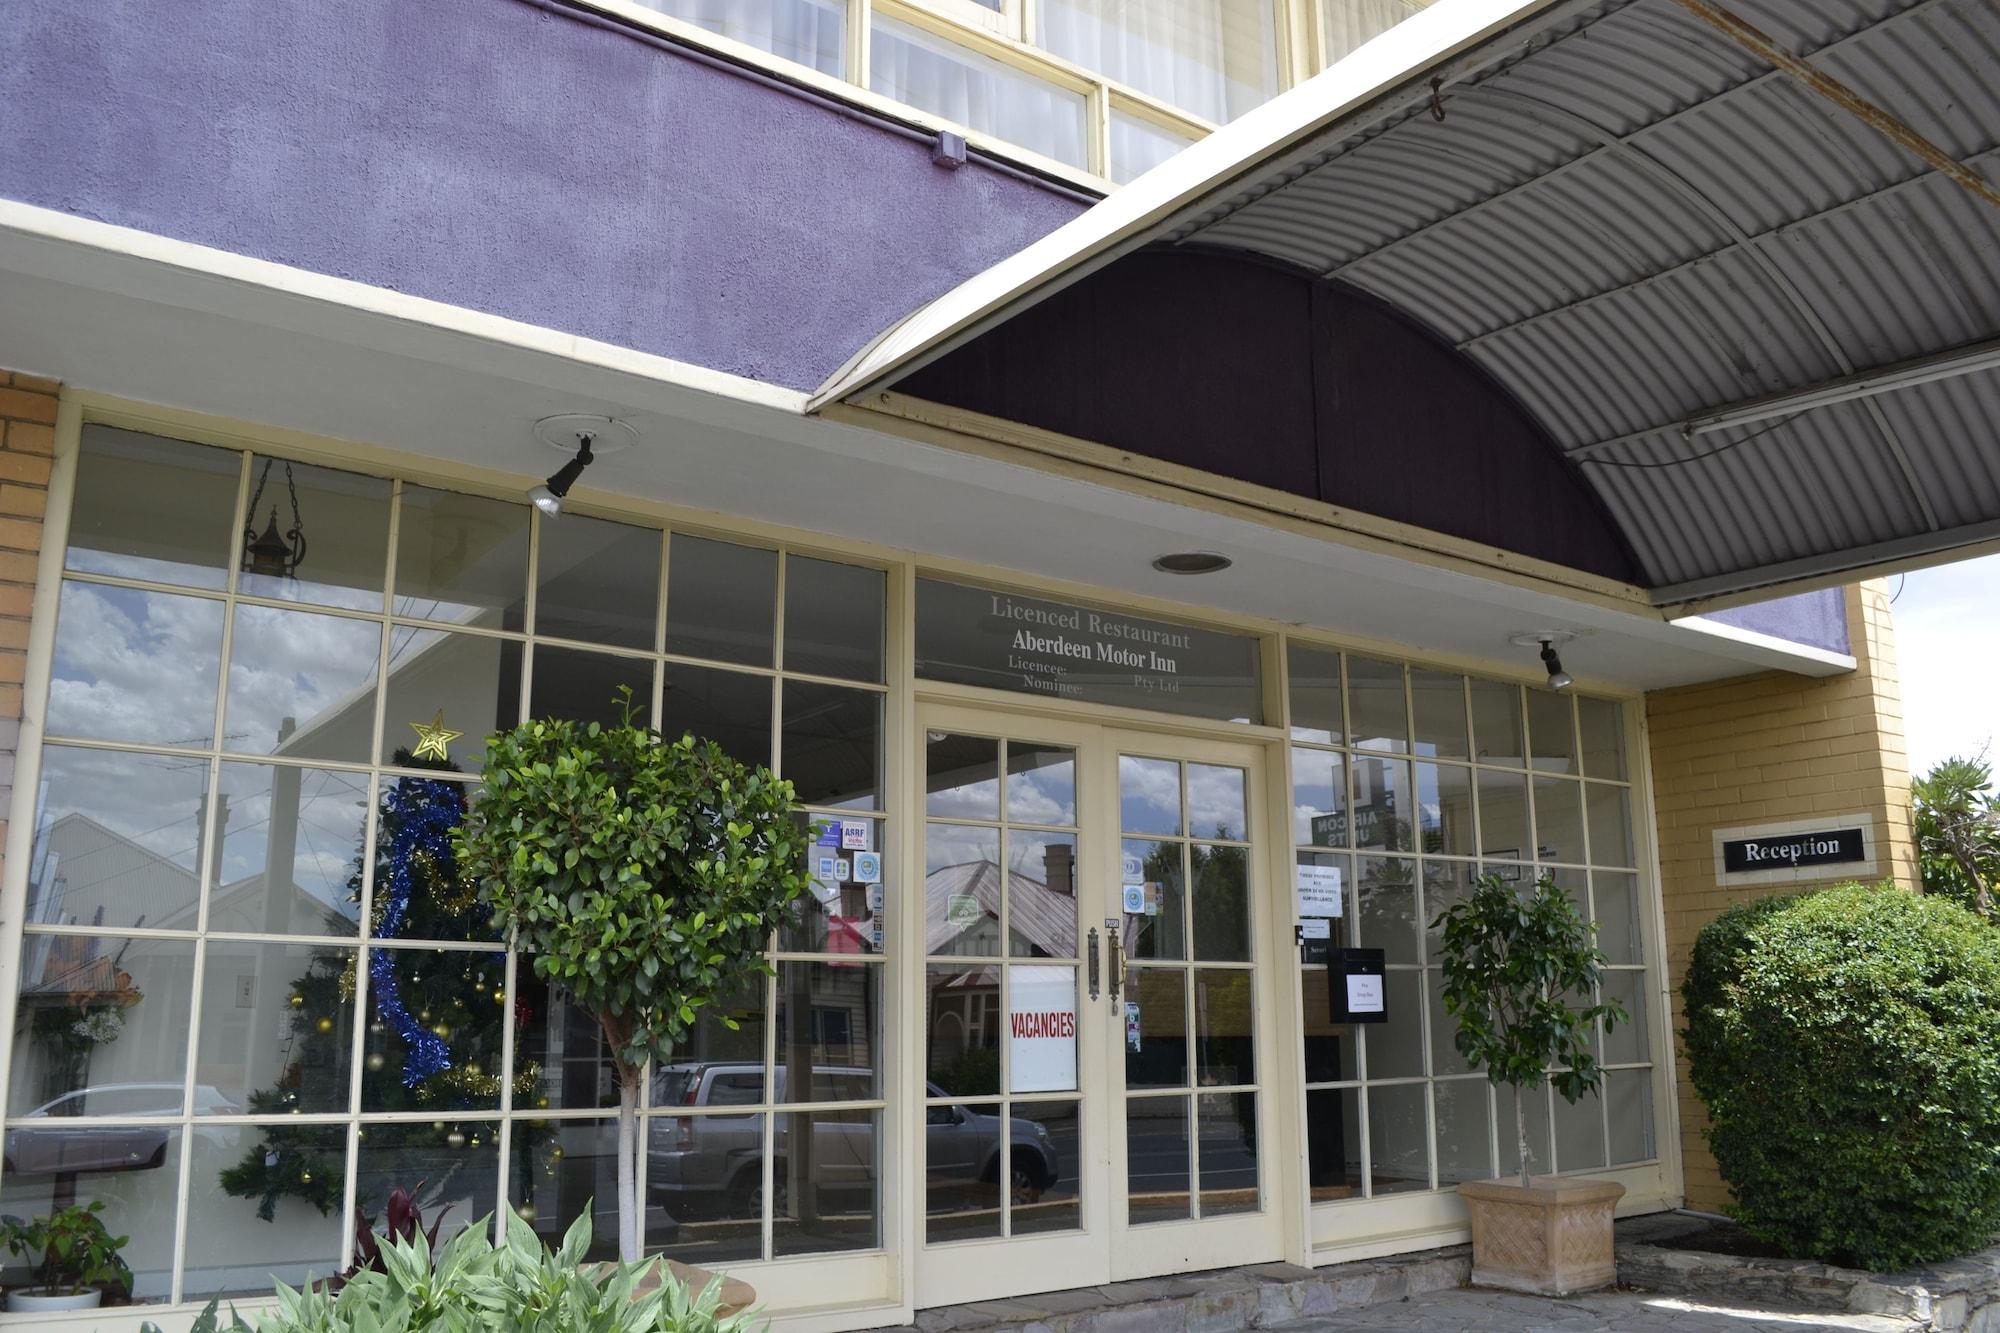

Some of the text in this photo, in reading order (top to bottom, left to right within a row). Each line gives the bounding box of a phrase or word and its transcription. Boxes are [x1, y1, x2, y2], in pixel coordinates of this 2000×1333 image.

[990, 596, 1192, 649] Licenced Restaurant
[1012, 629, 1177, 673] Aberdeen Motor Inn
[1134, 675, 1154, 693] Pty
[1160, 678, 1180, 694] Ltd
[1744, 837, 1840, 862] Reception
[1010, 1012, 1075, 1039] VACANCIES
